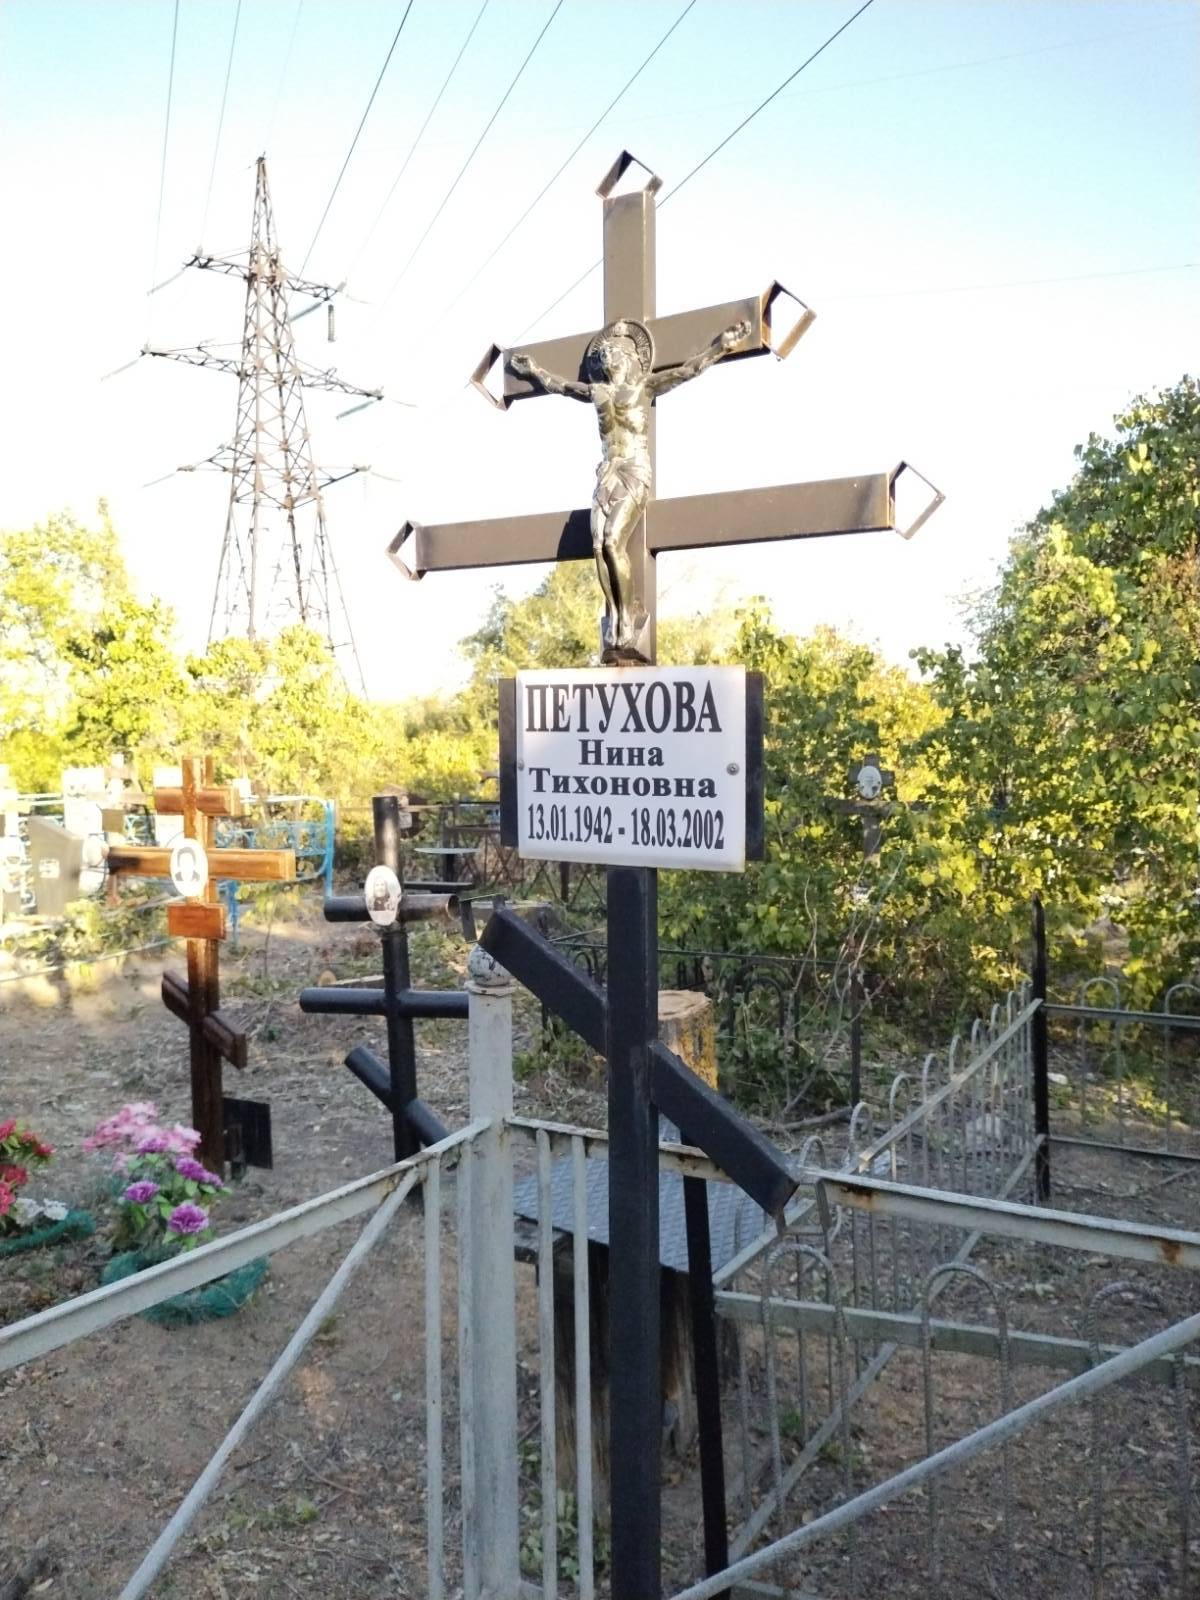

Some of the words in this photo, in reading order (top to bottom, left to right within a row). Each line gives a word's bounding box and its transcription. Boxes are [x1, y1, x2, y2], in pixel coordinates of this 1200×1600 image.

[525, 680, 722, 734] ПЕТУХОВА
[578, 739, 664, 766] Нина
[529, 767, 717, 798] Тихоновна
[527, 803, 613, 844] 13.01.1942
[631, 807, 724, 850] 18.03.2002
